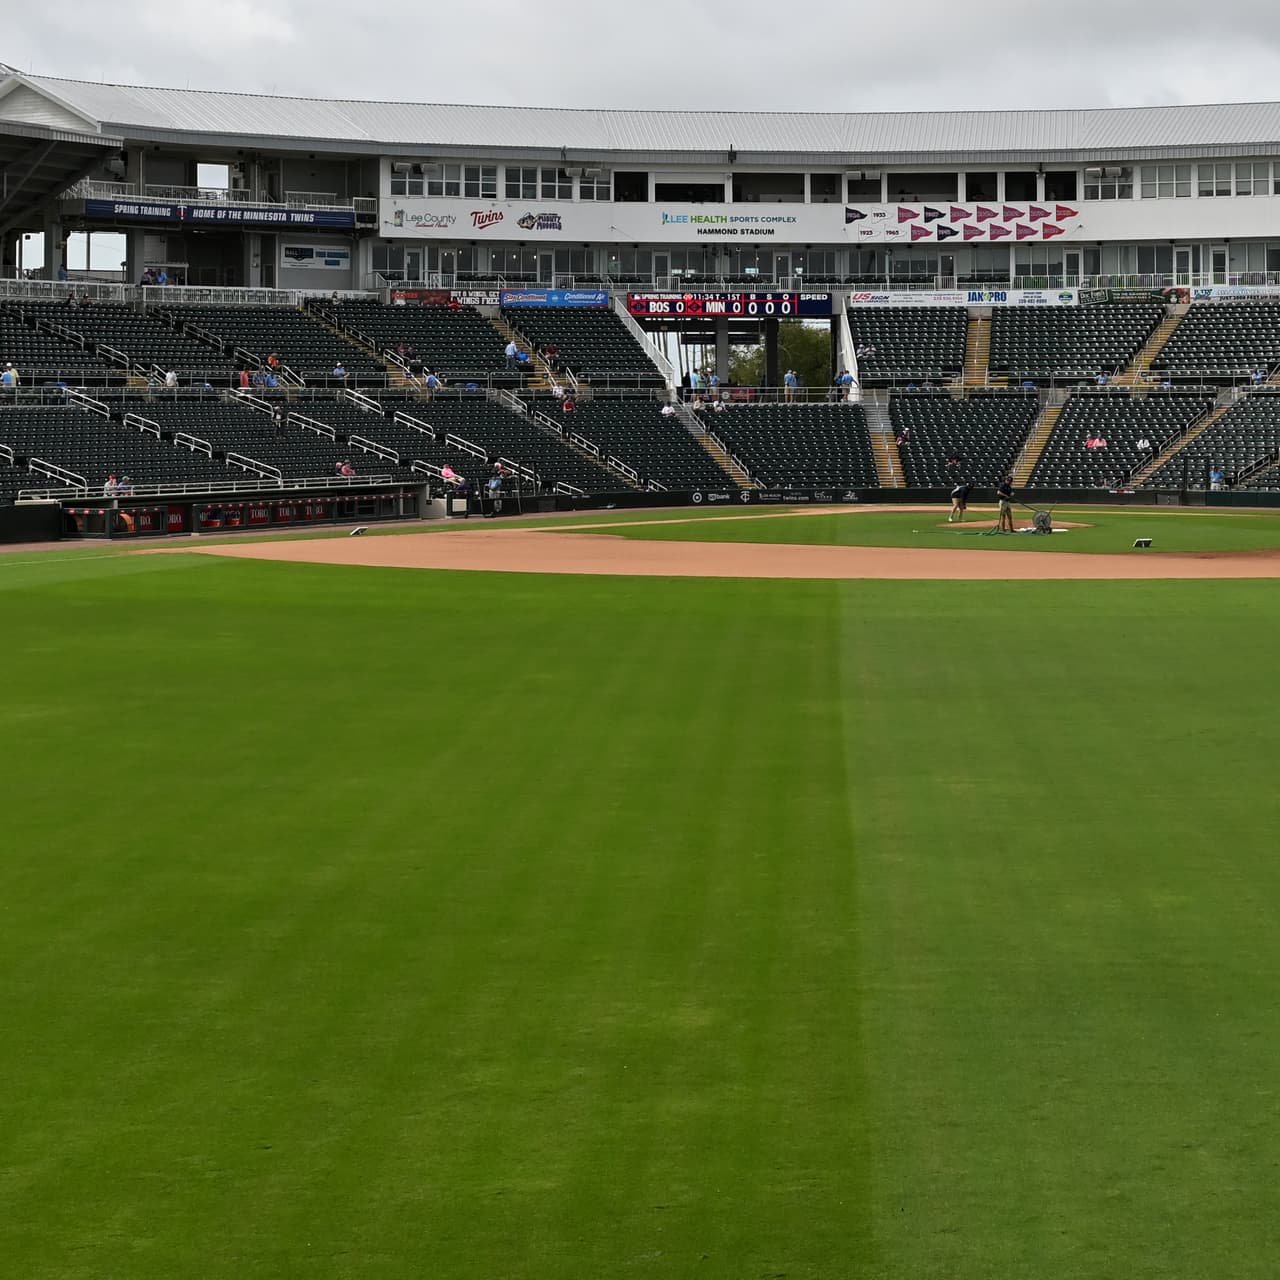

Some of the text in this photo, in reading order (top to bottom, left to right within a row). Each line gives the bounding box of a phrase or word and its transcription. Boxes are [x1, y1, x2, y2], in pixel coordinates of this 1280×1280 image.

[114, 204, 170, 217] SPRING TRAINING
[192, 209, 314, 222] HOME OF THE MINNESOTA TWINS
[406, 212, 456, 224] Lee County
[470, 210, 504, 230] Twins
[670, 215, 688, 223] LEE
[458, 297, 500, 305] WINGS FREE
[564, 292, 596, 300] Conditioned
[989, 292, 1006, 302] PRO
[649, 302, 684, 312] BOS 0
[706, 302, 740, 312] MIN 0
[749, 303, 757, 314] 0
[765, 303, 774, 314] 0
[782, 303, 790, 314] 0
[251, 509, 268, 519] TORO
